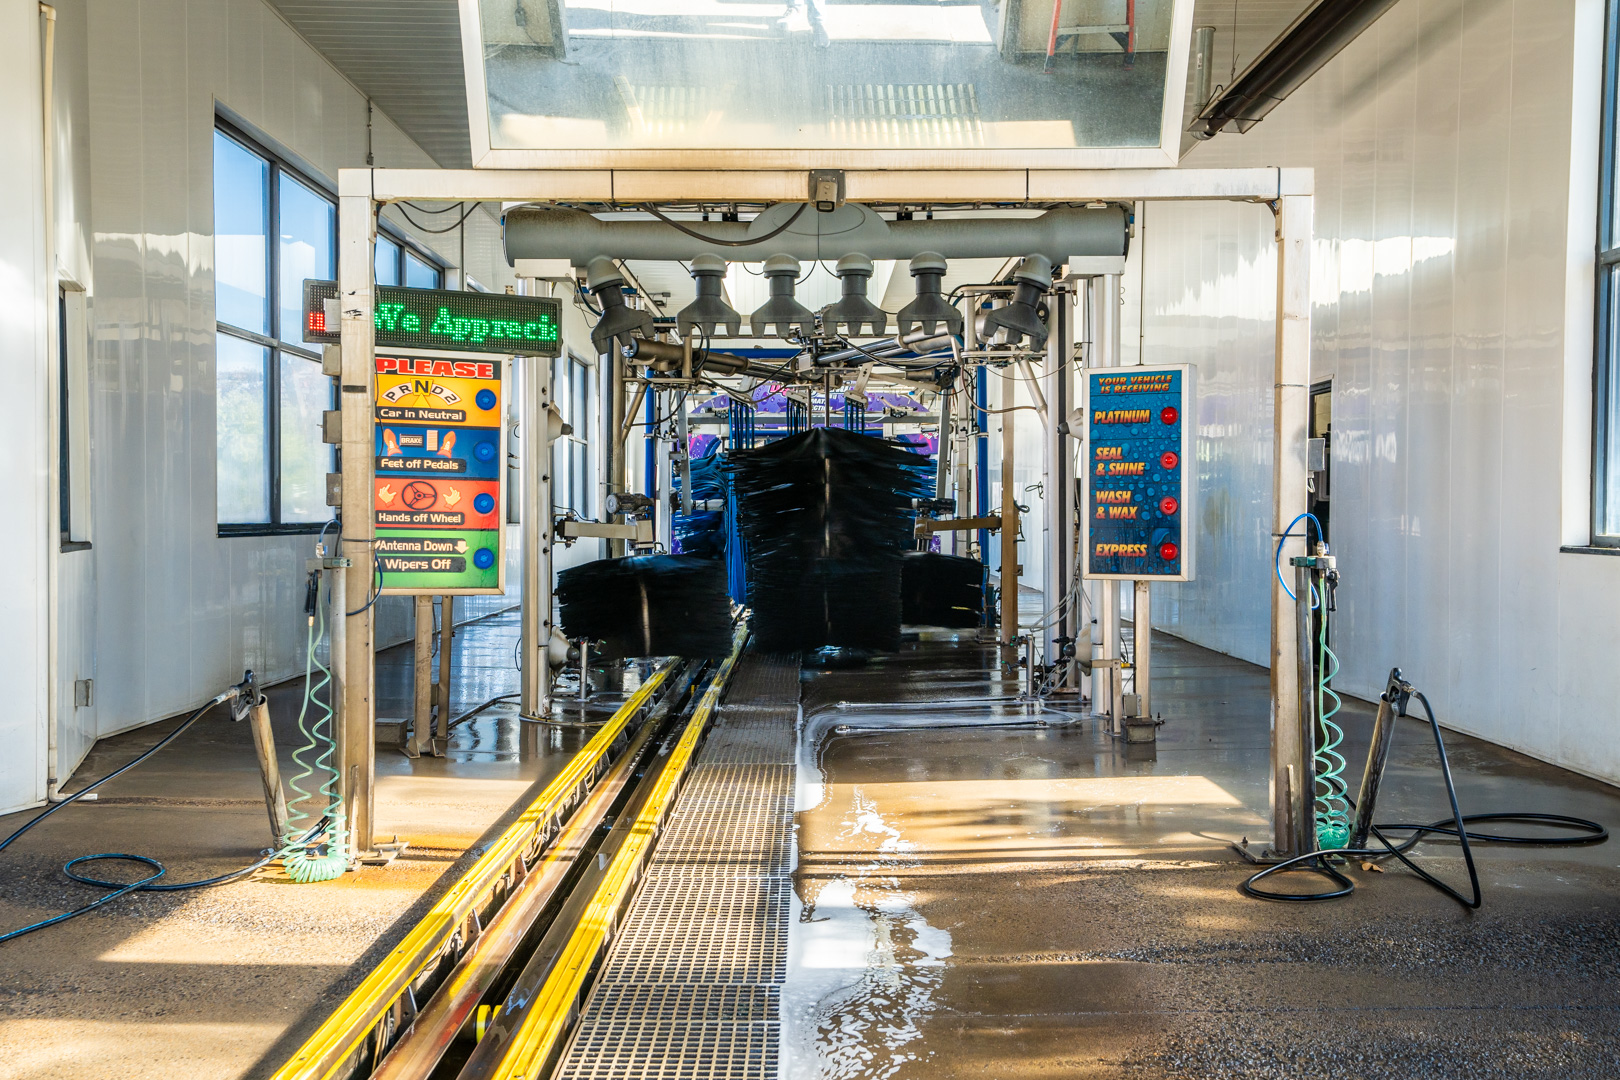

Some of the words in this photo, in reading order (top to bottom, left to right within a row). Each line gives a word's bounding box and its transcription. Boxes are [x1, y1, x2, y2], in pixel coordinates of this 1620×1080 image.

[375, 357, 494, 379] PLEASE
[1098, 377, 1127, 386] YOUR
[1130, 375, 1173, 385] VEHICLE
[1100, 386, 1111, 394] IS
[1114, 383, 1170, 394] RECEIVING
[380, 408, 401, 418] Car
[405, 410, 416, 418] in
[419, 410, 463, 420] Neutral
[1094, 409, 1151, 424] PLATINUM
[1095, 447, 1123, 460] SEAL
[381, 458, 404, 468] Feet
[406, 459, 421, 469] off
[424, 460, 459, 470] Pedals
[1095, 462, 1106, 476] &
[1108, 462, 1146, 476] SHINE
[1096, 490, 1132, 504] WASH
[378, 513, 411, 522] Hands
[413, 513, 428, 522] off
[430, 513, 461, 523] Wheel
[1095, 506, 1106, 519] &
[1109, 506, 1138, 519] WAX
[379, 540, 421, 551] Antenna
[424, 540, 453, 552] Down
[1095, 543, 1148, 557] EXPRESS
[385, 559, 429, 571] Wipers
[431, 559, 452, 570] Off
